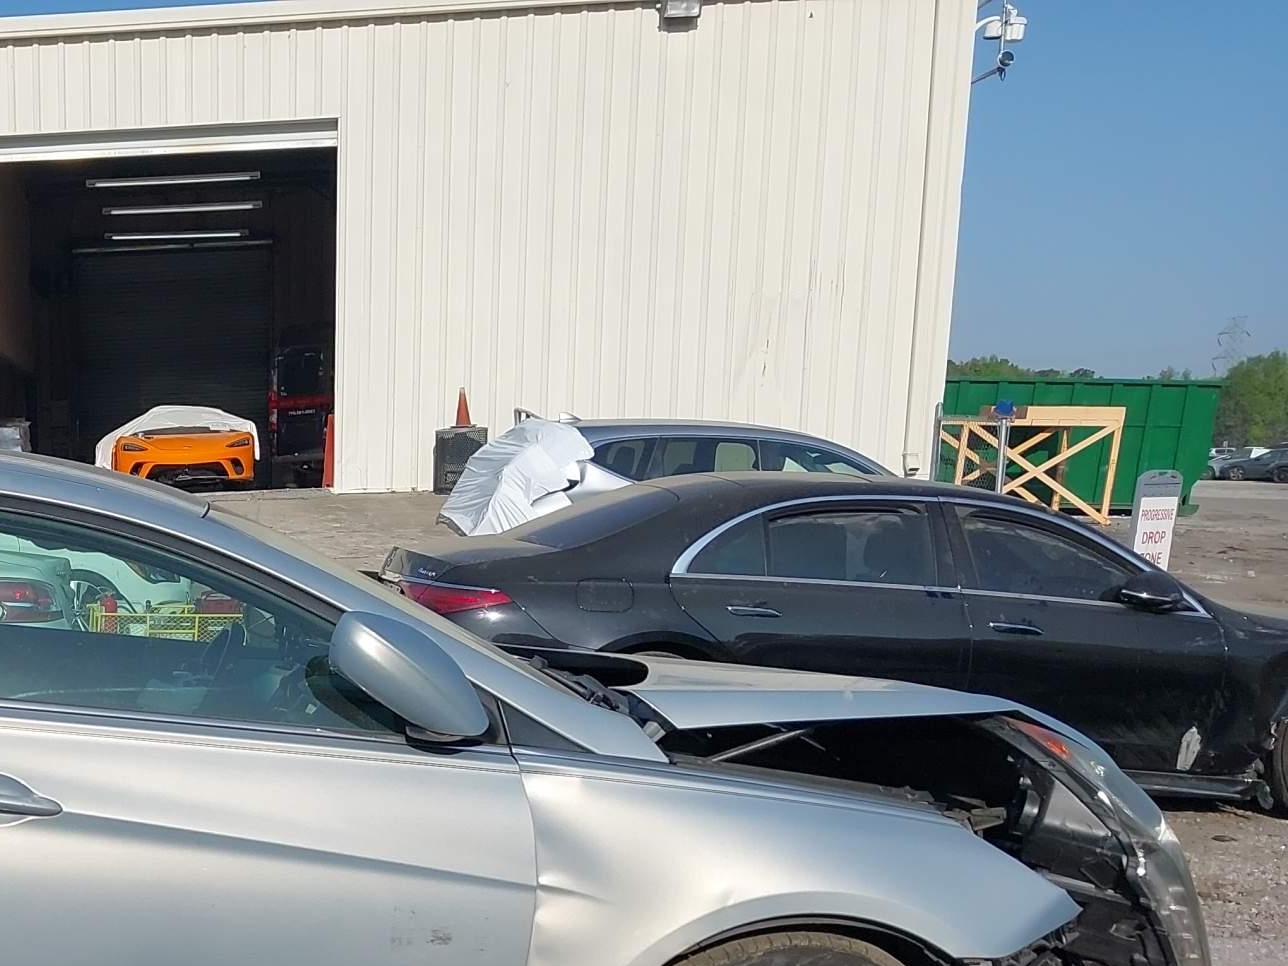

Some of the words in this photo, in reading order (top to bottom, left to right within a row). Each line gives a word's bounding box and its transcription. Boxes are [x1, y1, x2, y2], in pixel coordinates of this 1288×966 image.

[1142, 508, 1174, 520] PROGRESSIVE
[1142, 531, 1166, 544] DROP
[1141, 551, 1162, 564] ONE
